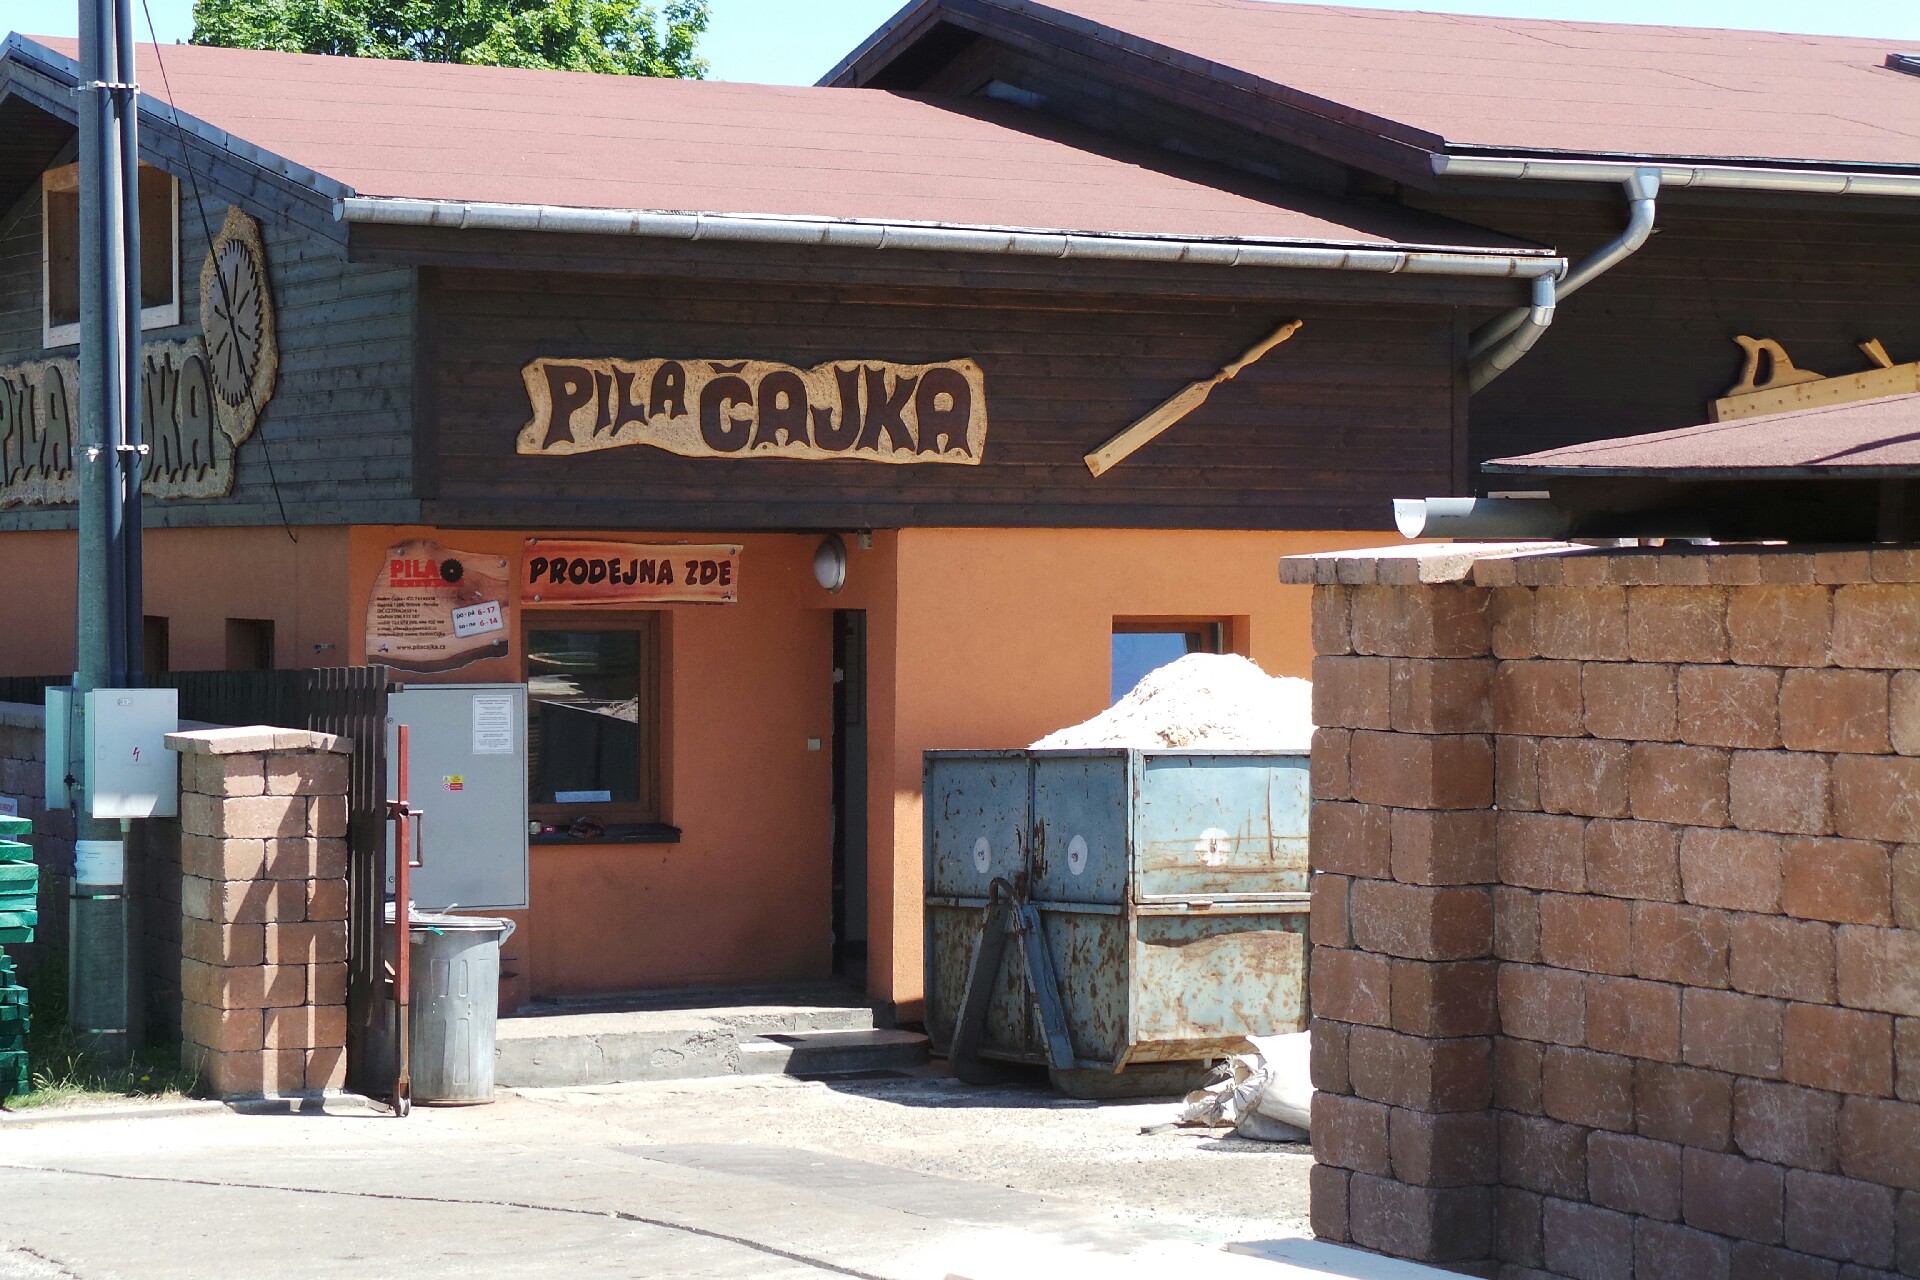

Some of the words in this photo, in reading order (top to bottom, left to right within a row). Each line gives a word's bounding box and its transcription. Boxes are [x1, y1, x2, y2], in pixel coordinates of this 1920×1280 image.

[542, 361, 687, 450] PILA
[699, 362, 973, 457] ČAJKA
[391, 559, 440, 578] PILA
[530, 556, 673, 585] PRODEJNA
[685, 560, 731, 586] ZDE
